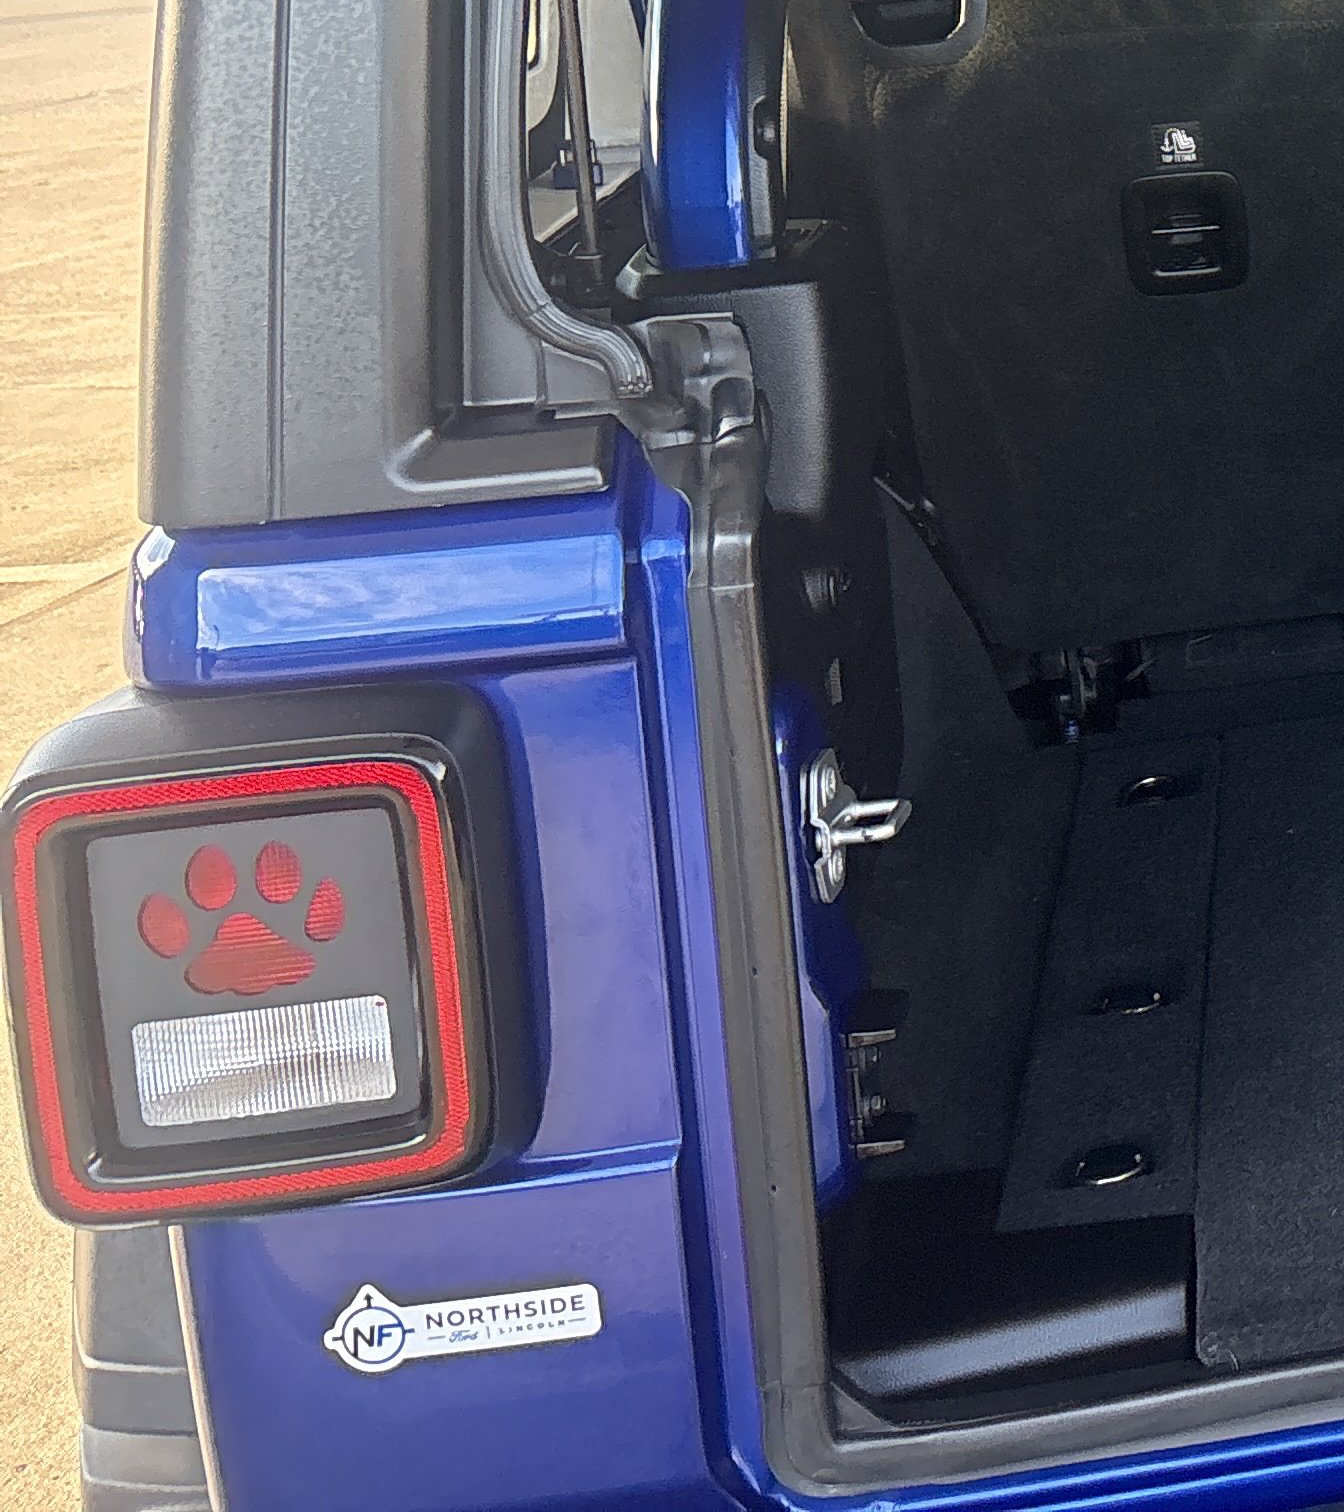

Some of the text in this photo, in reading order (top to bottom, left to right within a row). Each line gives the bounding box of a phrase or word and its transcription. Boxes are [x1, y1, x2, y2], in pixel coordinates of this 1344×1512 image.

[425, 1293, 586, 1330] NORTHSIDE
[499, 1320, 566, 1335] LINCOLN
[353, 1324, 402, 1358] NF
